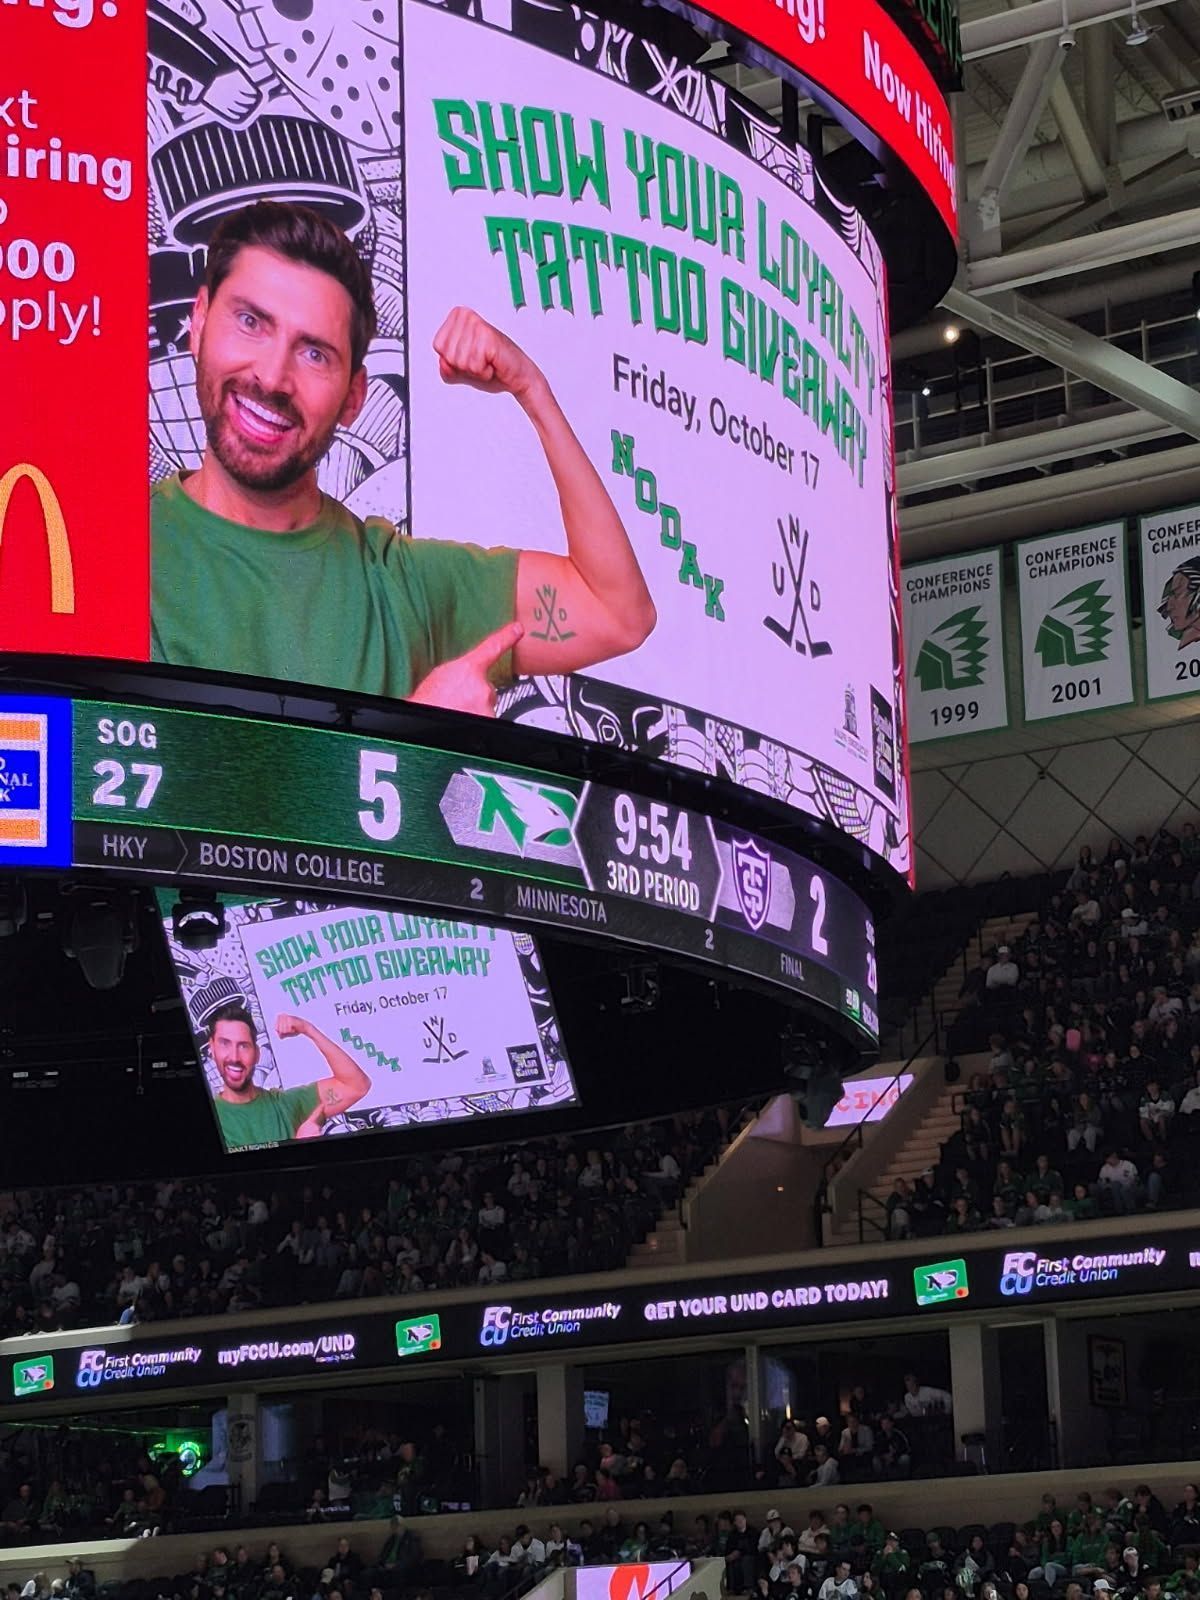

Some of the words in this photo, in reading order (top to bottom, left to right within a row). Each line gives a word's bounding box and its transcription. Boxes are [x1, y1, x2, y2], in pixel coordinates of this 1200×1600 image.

[863, 30, 911, 124] Now
[432, 99, 611, 212] SHOW
[624, 128, 746, 265] YOUR
[757, 197, 875, 415] LOYALTY
[484, 216, 708, 346] TATTOO
[721, 277, 868, 488] GIVEAWAY
[613, 353, 701, 434] Friday,
[709, 397, 795, 475] October
[802, 450, 820, 490] 17
[1025, 536, 1117, 567] CONFERENCE
[1029, 551, 1115, 579] CHAMPIONS
[906, 563, 993, 592] CONFERENCE
[910, 578, 991, 604] CHAMPIONS
[1051, 677, 1102, 704] 2001
[930, 700, 980, 727] 1999
[98, 718, 157, 750] SOG
[93, 760, 163, 810] 27
[358, 749, 401, 842] 5
[614, 793, 692, 871] 9:54
[102, 834, 148, 861] HKY
[200, 842, 288, 875] BOSTON
[295, 853, 386, 887] COLLEGE
[470, 878, 485, 901] 2
[606, 860, 640, 896] 3RD
[644, 869, 700, 911] PERIOD
[517, 885, 608, 923] MINNESOTA
[705, 928, 715, 950] 2
[809, 875, 828, 956] 2
[255, 930, 323, 980] SHOW
[320, 914, 386, 954] YOUR
[280, 954, 374, 1007] TATTOO
[374, 946, 491, 981] GIVEAWAY
[781, 952, 806, 981] FINAL
[334, 1000, 377, 1016] Friday,
[379, 992, 430, 1009] October
[434, 986, 448, 1000] 17
[1036, 1258, 1069, 1274] First
[1072, 1247, 1166, 1270] Community
[1036, 1270, 1076, 1287] Credit
[1079, 1267, 1119, 1283] Union
[511, 1311, 539, 1326] First
[541, 1301, 622, 1323] Community
[644, 1301, 676, 1321] GET
[679, 1297, 729, 1318] YOUR
[731, 1294, 769, 1314] UND
[772, 1288, 822, 1308] CARD
[824, 1279, 889, 1302] TODAY!
[510, 1323, 545, 1339] Credit
[547, 1320, 581, 1335] Union
[105, 1356, 130, 1369] First
[131, 1347, 202, 1367] Community
[218, 1334, 356, 1367] myFCCU.com/UND
[104, 1366, 135, 1380] Credit
[136, 1363, 166, 1378] Union
